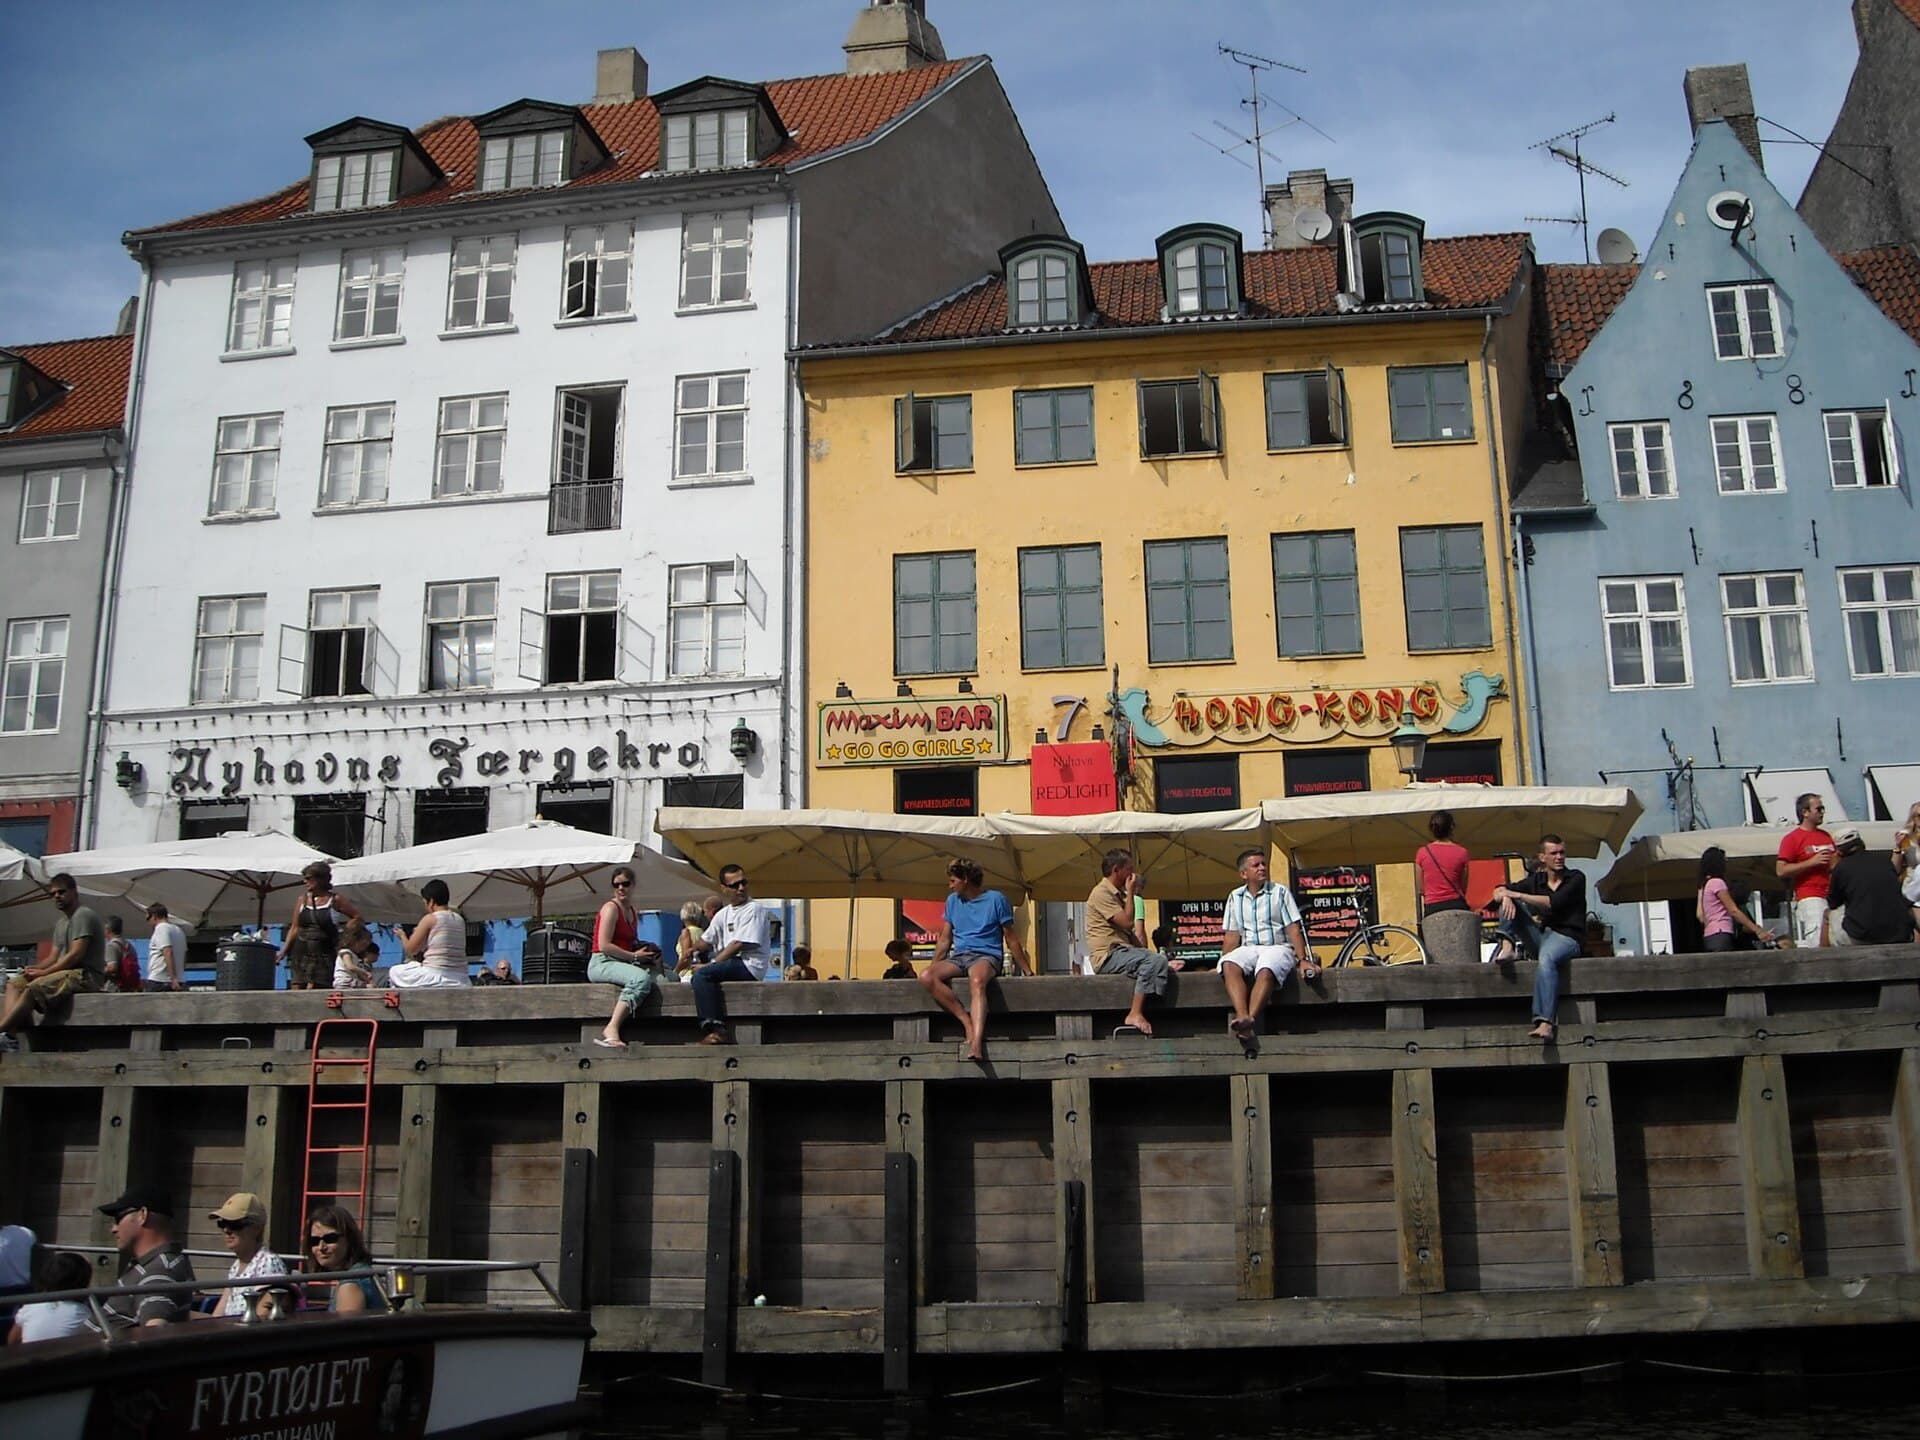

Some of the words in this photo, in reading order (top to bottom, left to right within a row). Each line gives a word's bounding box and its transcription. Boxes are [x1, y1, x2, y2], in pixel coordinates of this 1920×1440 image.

[826, 706, 932, 736] Maxim
[936, 705, 993, 731] BAR
[1052, 694, 1088, 740] 7
[1176, 686, 1439, 732] HONG-KONG
[843, 742, 873, 758] GO
[878, 741, 909, 757] GO
[912, 738, 976, 756] GIRLS
[171, 747, 401, 797] Nyhavns
[1036, 783, 1111, 800] REDLIGHT
[1182, 903, 1199, 912] OPEN
[1313, 897, 1331, 907] OPEN
[190, 1357, 370, 1432] FYRTØJET
